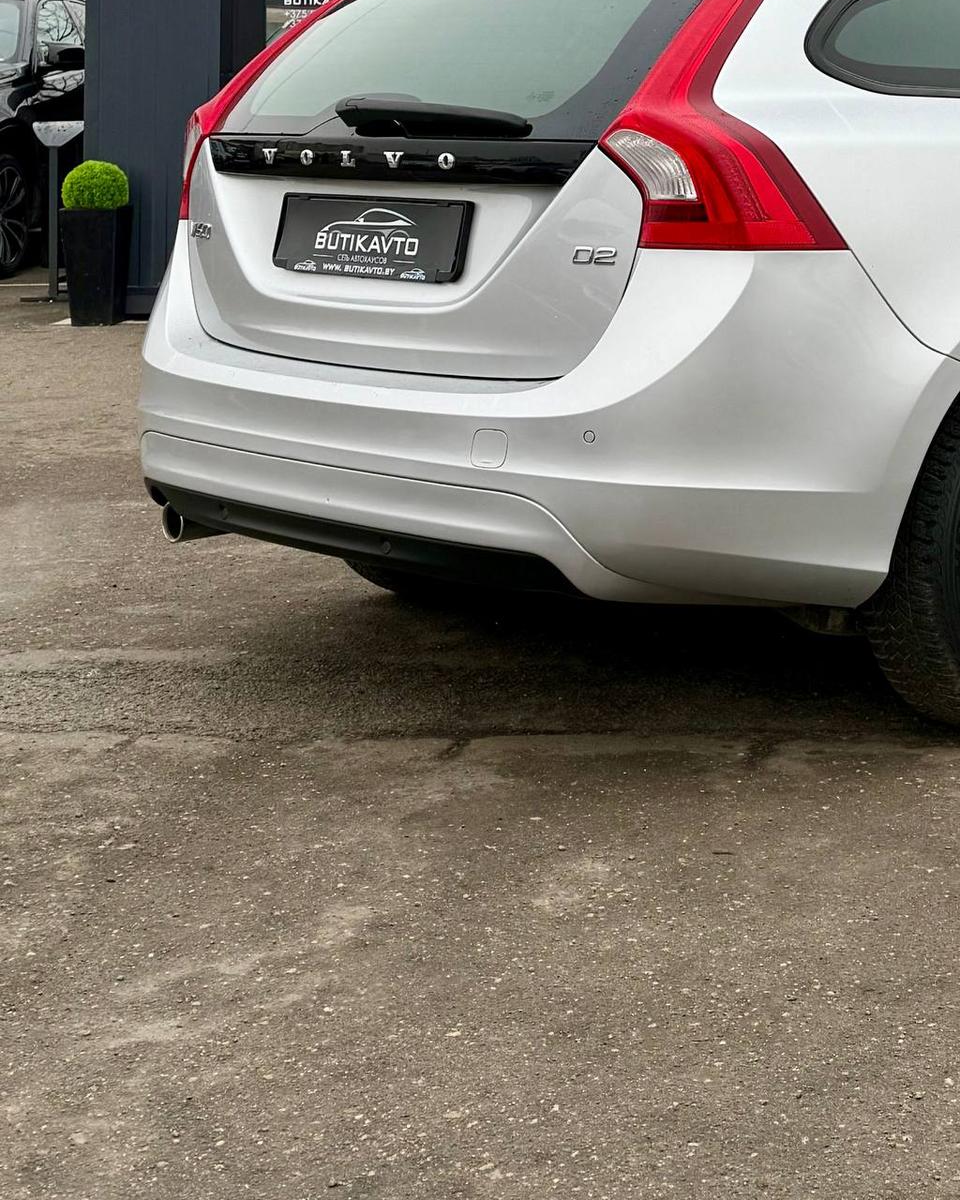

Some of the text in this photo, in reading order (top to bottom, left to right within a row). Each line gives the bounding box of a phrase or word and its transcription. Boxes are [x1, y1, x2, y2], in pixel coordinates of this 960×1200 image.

[262, 148, 455, 170] VOLVO
[314, 232, 419, 256] BUTIKAVTO
[350, 255, 387, 265] АВТОХАУСОВ
[573, 246, 617, 266] D2
[343, 264, 395, 276] BUTIKAVTO.BY
